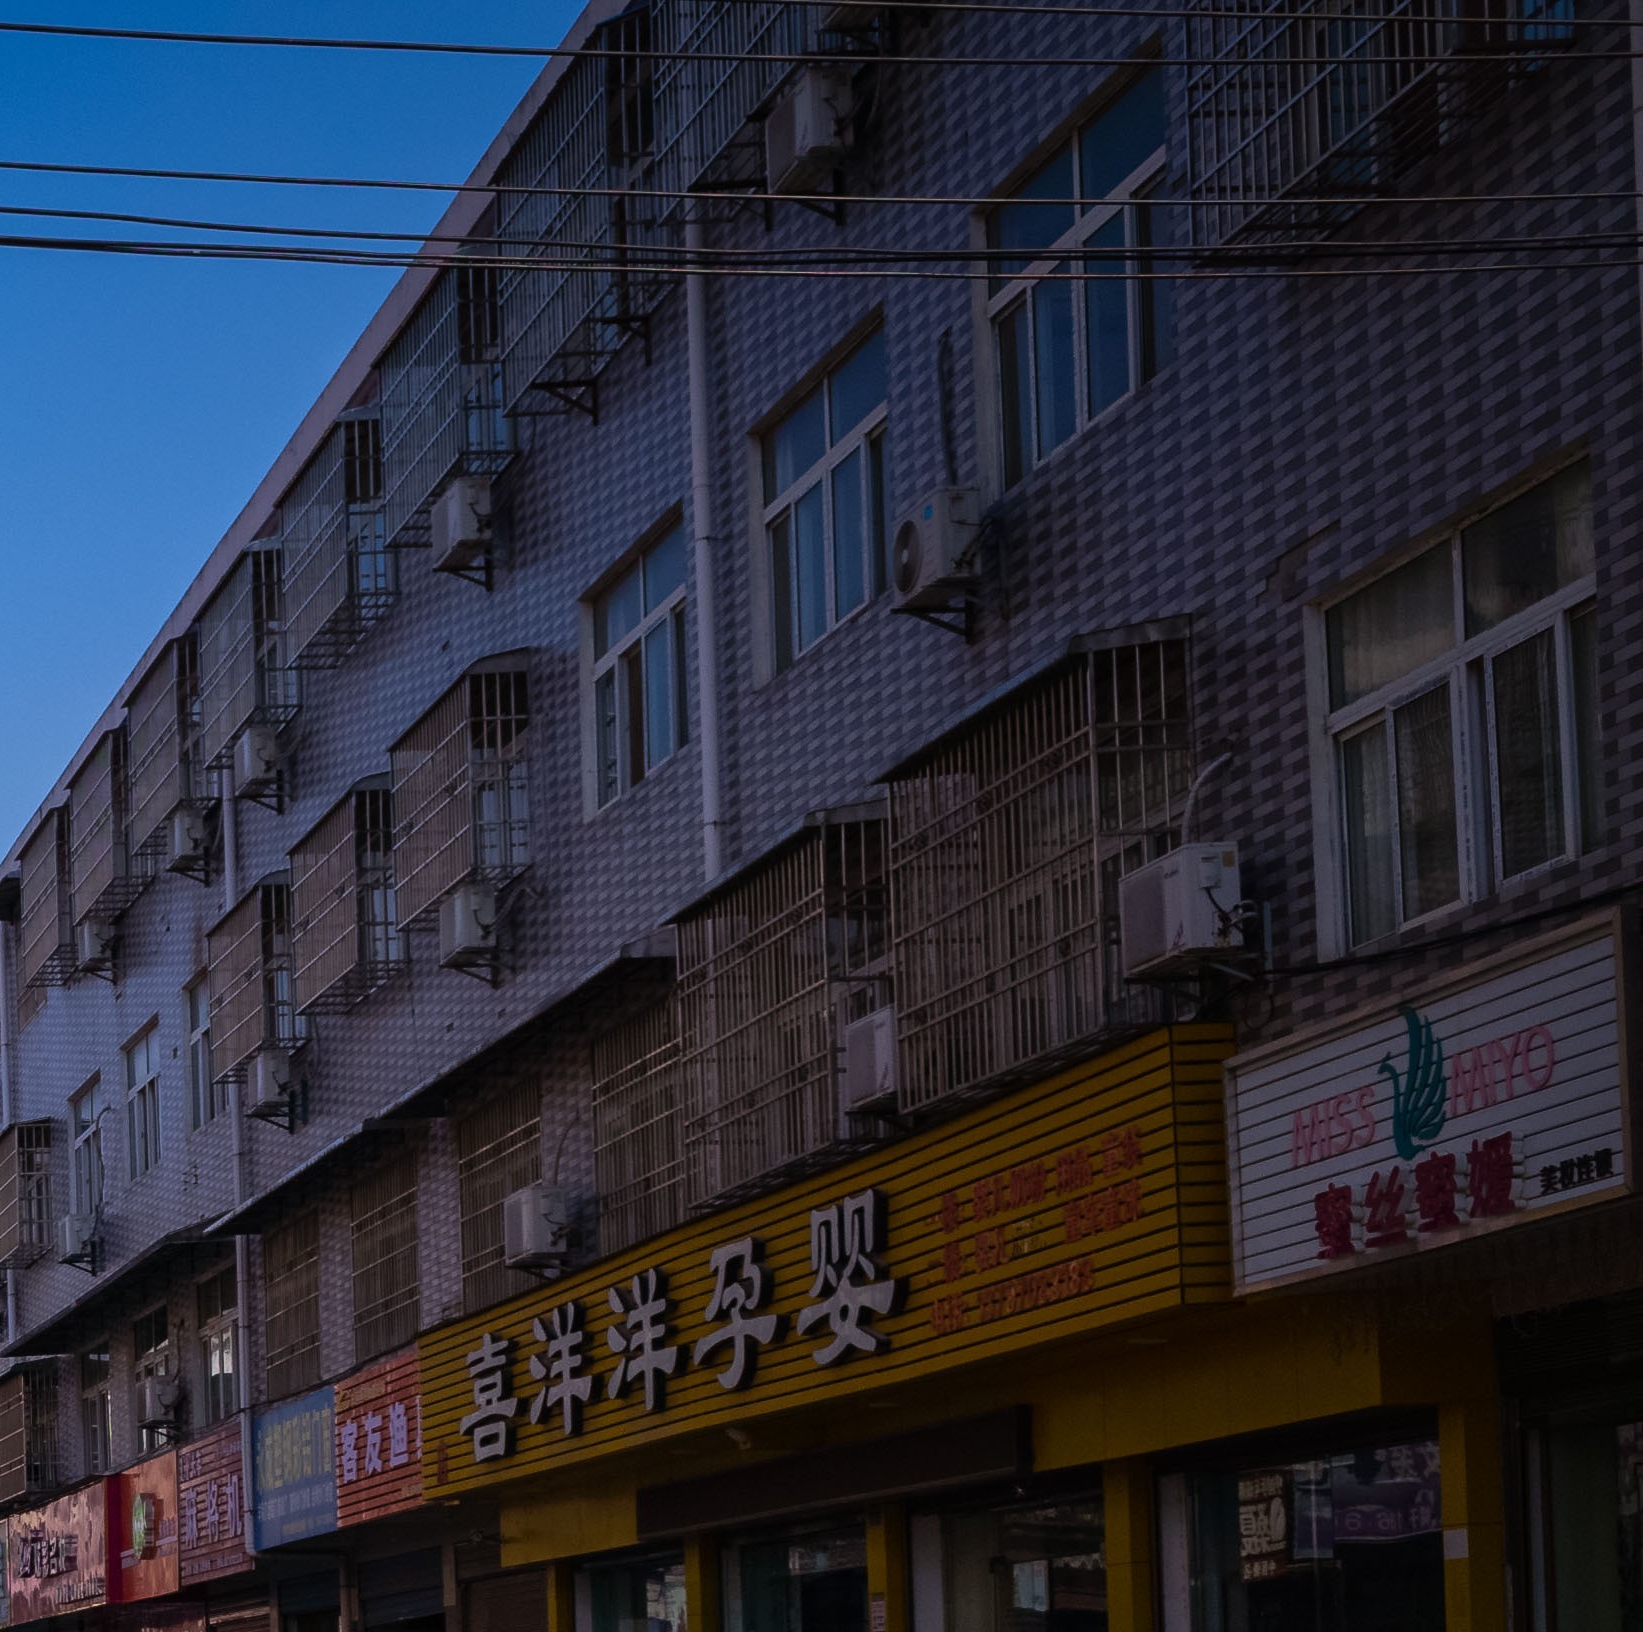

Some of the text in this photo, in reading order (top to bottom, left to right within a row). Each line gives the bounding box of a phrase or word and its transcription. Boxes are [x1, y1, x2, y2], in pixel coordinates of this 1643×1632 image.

[1291, 1023, 1555, 1167] MISS MIYO
[459, 1188, 899, 1464] 喜洋洋孕婴
[341, 1394, 424, 1485] 客友渔
